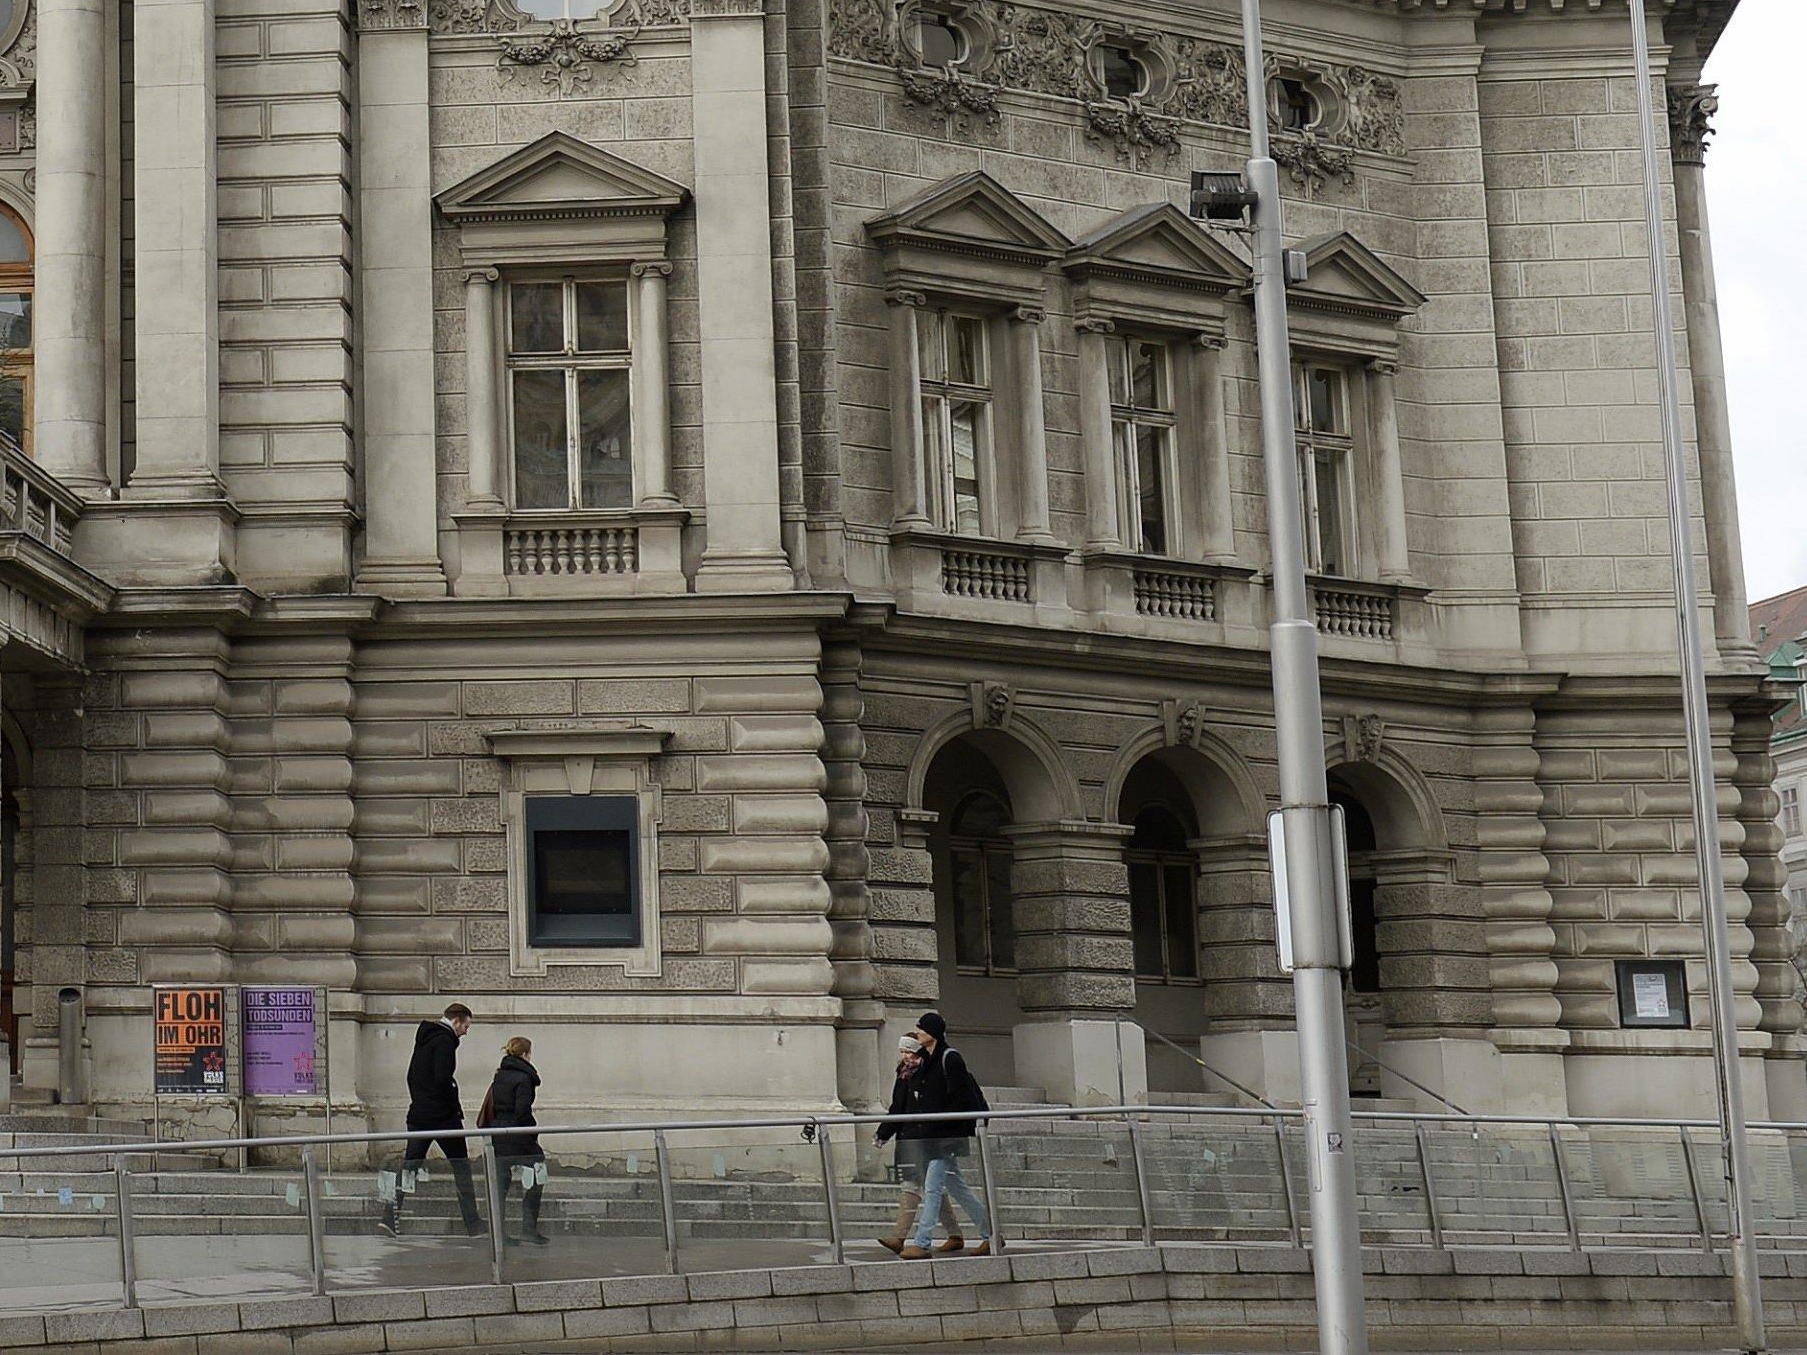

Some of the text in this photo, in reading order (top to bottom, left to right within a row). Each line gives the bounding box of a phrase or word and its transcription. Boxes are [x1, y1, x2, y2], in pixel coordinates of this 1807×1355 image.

[158, 993, 220, 1020] FLOH
[247, 992, 311, 1006] DIE SIEBEN
[158, 1025, 220, 1044] IM OHR
